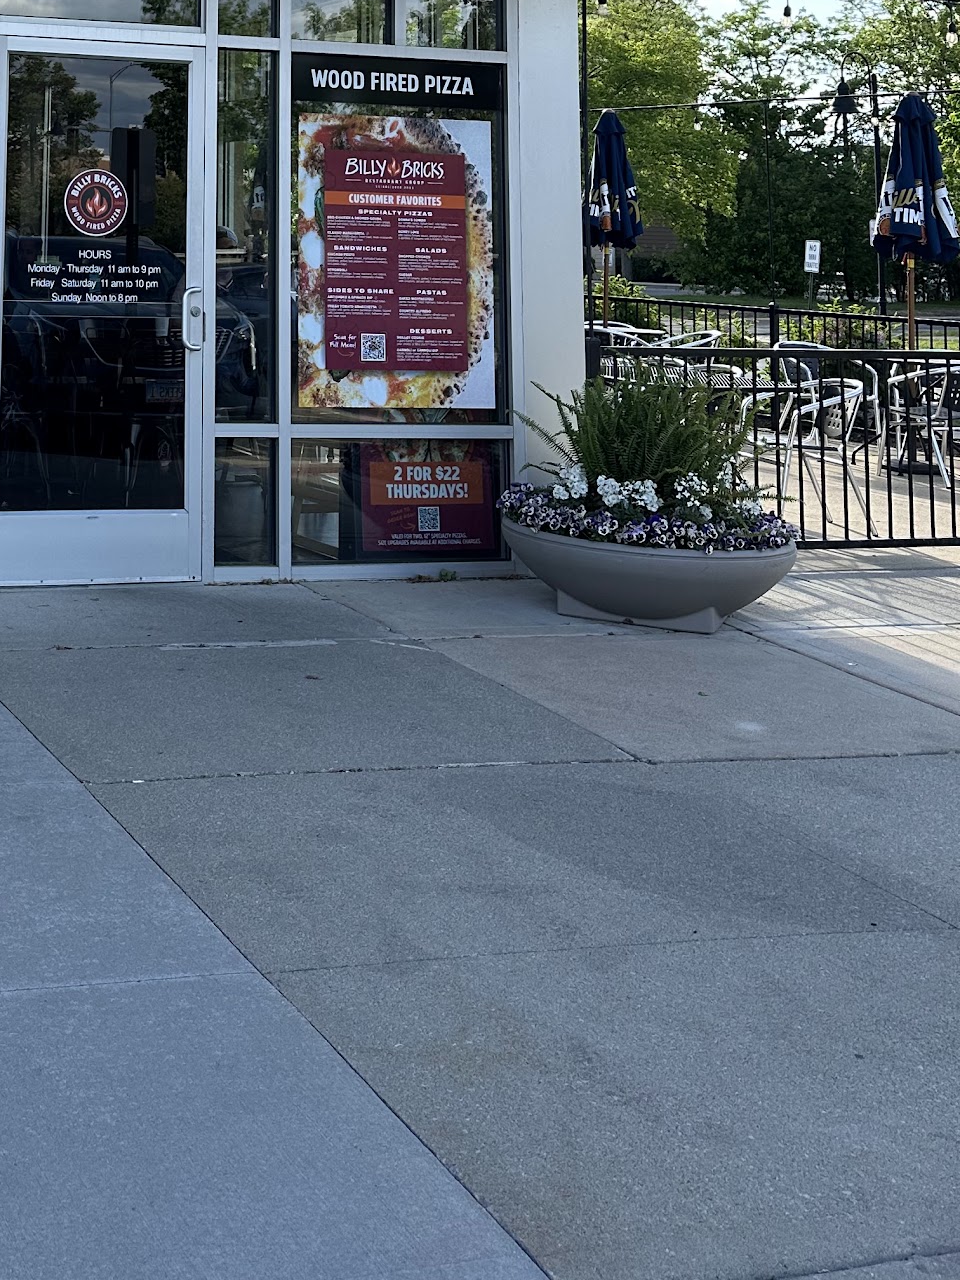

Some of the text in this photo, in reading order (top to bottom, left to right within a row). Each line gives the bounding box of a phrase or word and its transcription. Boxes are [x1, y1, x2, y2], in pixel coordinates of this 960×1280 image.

[311, 68, 474, 96] WOOD FIRED PIZZA
[345, 157, 445, 179] BILLY BRICKS
[71, 174, 122, 198] BILLY BRICKS
[348, 193, 442, 207] CUSTOMER FAVORITES
[71, 206, 121, 230] WOOD FIRED PIZZA
[358, 208, 402, 216] SPECIALTY
[894, 207, 924, 226] TIM
[78, 249, 112, 259] HOURS
[333, 244, 388, 252] SANDWICHES
[27, 264, 60, 275] Monday
[67, 264, 104, 276] Thursday
[108, 265, 116, 273] 11
[132, 265, 139, 274] to
[141, 265, 147, 274] 9
[148, 266, 161, 276] pm
[30, 278, 159, 290] Friday Saturday 11 am to 10 pm
[51, 292, 138, 304] Sunday Noon to 8 pm
[348, 333, 357, 342] for
[393, 465, 460, 481] 2 FOR $22
[385, 483, 469, 499] THURSDAYS!
